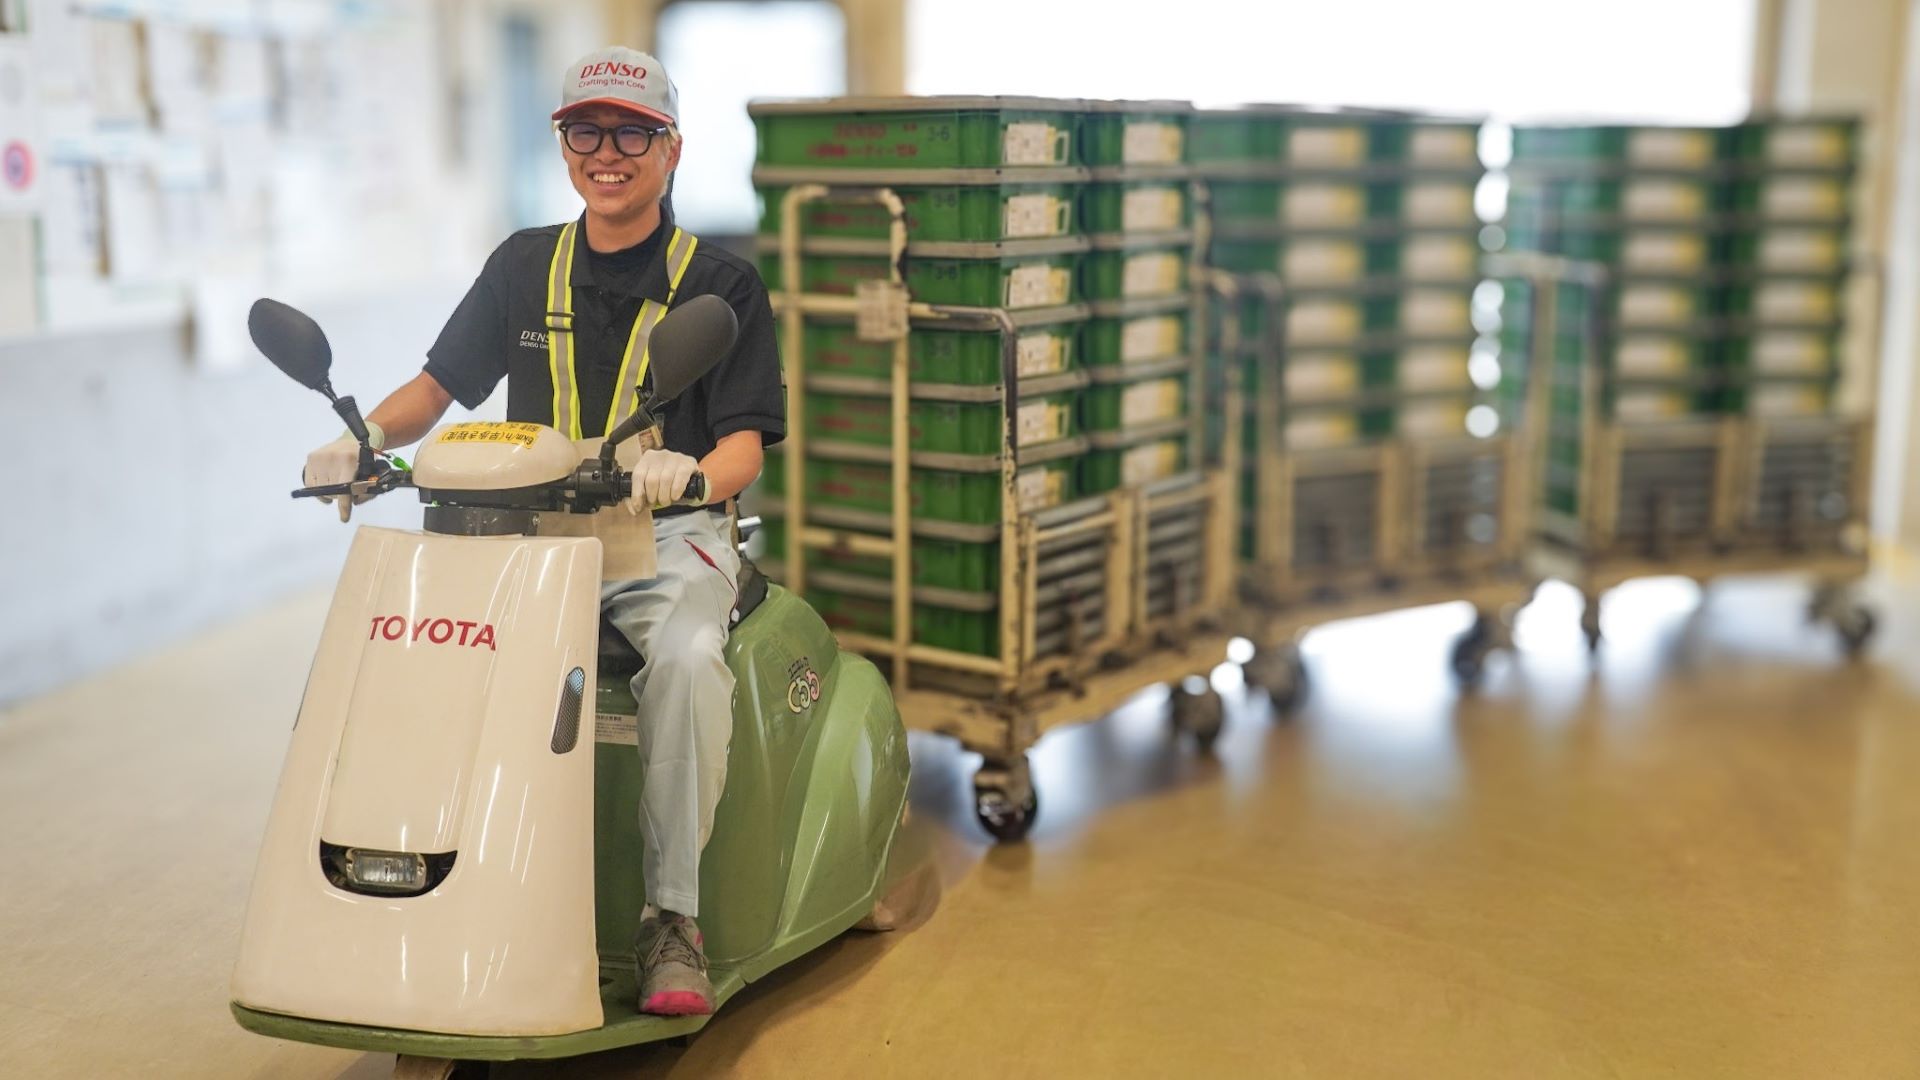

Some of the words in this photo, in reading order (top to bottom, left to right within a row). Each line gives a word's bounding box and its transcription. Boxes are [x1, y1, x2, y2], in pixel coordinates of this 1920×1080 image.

[580, 62, 647, 80] DENSO
[578, 79, 608, 88] Crafting
[611, 78, 624, 86] the
[626, 80, 645, 90] Core
[520, 330, 549, 343] DENS
[369, 615, 496, 651] TOYOTA
